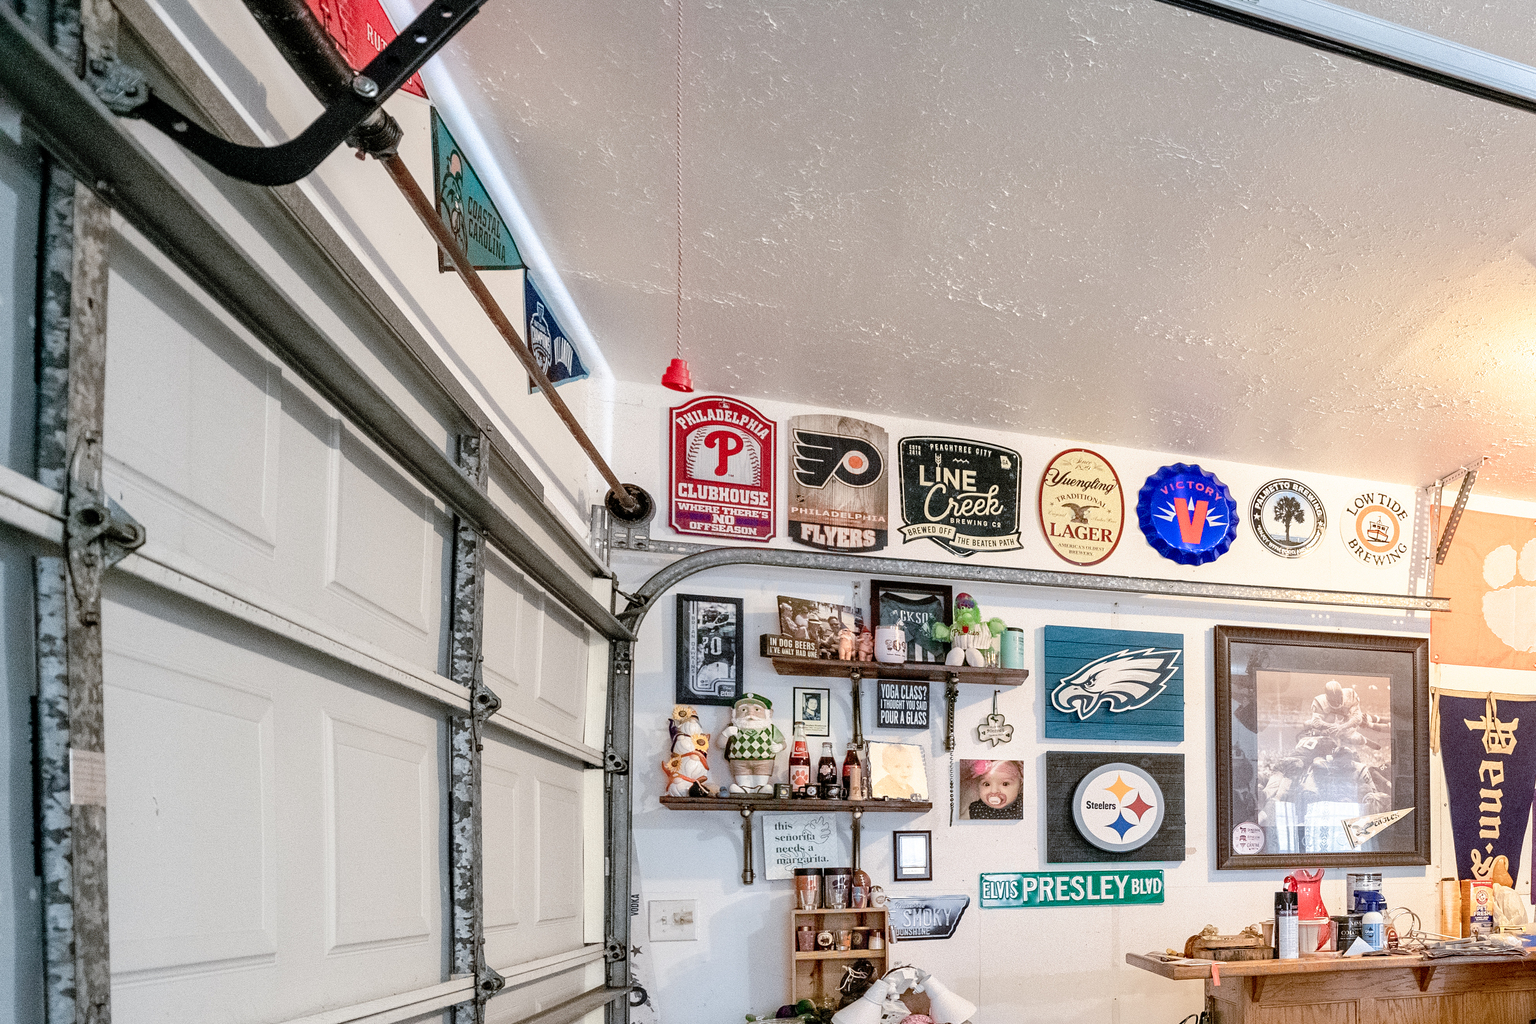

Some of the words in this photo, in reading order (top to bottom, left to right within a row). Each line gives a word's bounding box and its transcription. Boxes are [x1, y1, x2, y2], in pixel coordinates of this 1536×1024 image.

[467, 196, 501, 238] COASTAL
[468, 218, 506, 263] CAROLINA
[676, 408, 770, 440] PHILADELPHIA
[704, 430, 744, 477] P
[930, 443, 973, 455] PEACHTREE
[975, 448, 992, 458] CITY
[919, 464, 977, 491] LINE
[1044, 467, 1118, 495] Yuengling
[678, 482, 769, 506] CLUBHOUSE
[1160, 480, 1223, 502] VICTORY
[1254, 481, 1291, 510] PALMETTO
[1292, 482, 1324, 517] BREWING
[924, 484, 1004, 522] Creek
[1055, 493, 1107, 510] TRADITIONAL
[1346, 492, 1375, 517] LOW
[1377, 493, 1409, 522] TIDE
[678, 502, 719, 514] WHERE
[721, 507, 769, 519] THERE'S
[791, 506, 886, 523] PHILADELPHIA
[712, 514, 735, 525] NO
[1173, 497, 1209, 544] V
[689, 521, 758, 536] OFFSEASON
[800, 523, 877, 548] FLYERS
[907, 526, 937, 537] BREWED
[939, 527, 952, 536] OFF
[1050, 522, 1113, 543] LAGER
[957, 536, 970, 547] THE
[972, 538, 998, 547] BEATEN
[999, 538, 1015, 547] PATH
[1348, 538, 1408, 566] BREWING
[769, 637, 777, 646] IN
[779, 638, 793, 648] DOG
[769, 646, 780, 655] I'VE
[781, 647, 794, 656] ONLY
[795, 648, 806, 657] HAD
[880, 683, 899, 699] YOGA
[901, 685, 928, 700] CLASS?
[884, 699, 905, 709] THOUGHT
[906, 700, 915, 710] YOU
[916, 701, 928, 711] SAID
[880, 711, 899, 724] POUR
[900, 712, 905, 724] A
[906, 713, 927, 726] GLASS
[1086, 801, 1116, 811] Steelers
[774, 821, 793, 831] this
[774, 832, 815, 842] señorita
[776, 844, 805, 853] needs
[776, 854, 829, 867] margarita.
[982, 881, 1018, 899] ELVIS
[1023, 876, 1129, 901] PRESLEY
[1131, 878, 1162, 895] BLVD
[902, 910, 952, 927] SMOKY
